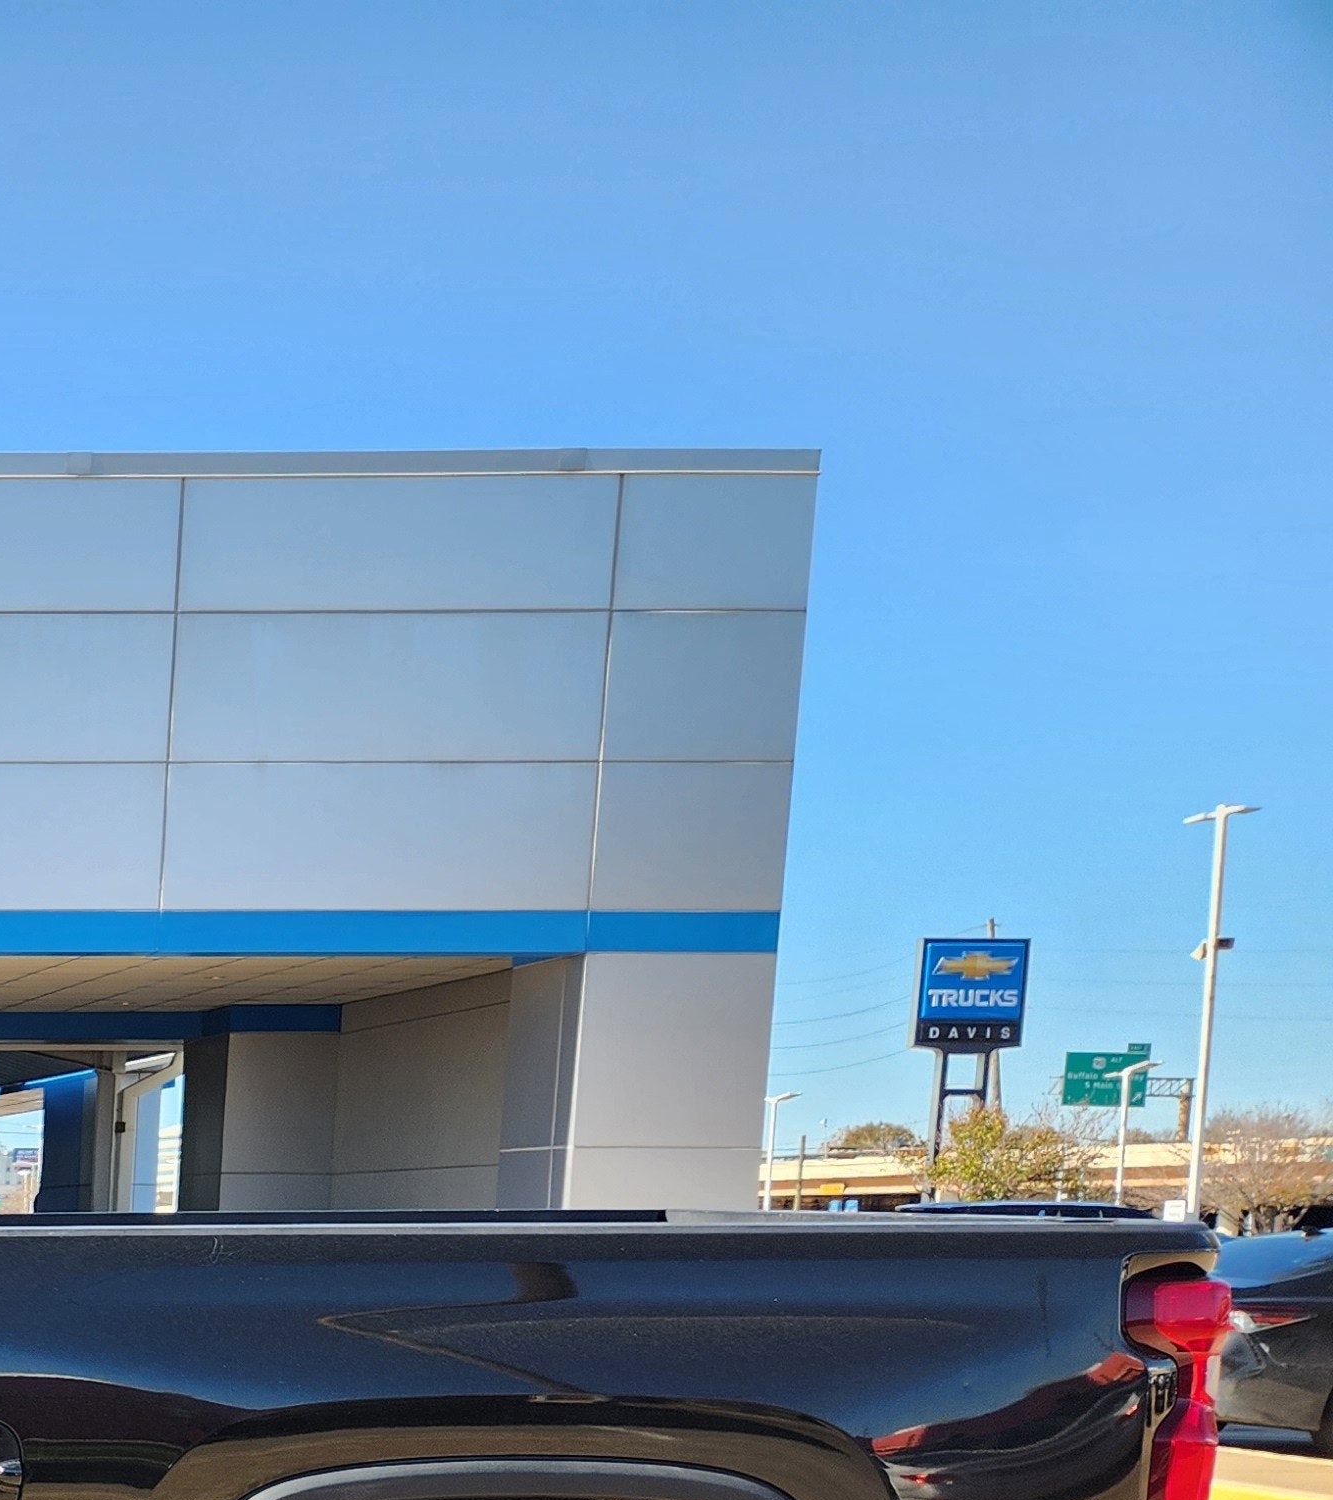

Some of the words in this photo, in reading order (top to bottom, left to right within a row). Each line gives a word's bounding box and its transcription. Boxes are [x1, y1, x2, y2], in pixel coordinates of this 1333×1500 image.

[928, 989, 1018, 1007] TRUCKS
[928, 1026, 1011, 1039] DAVIS
[1067, 1072, 1099, 1080] Buffalo
[1093, 1081, 1113, 1089] Main
